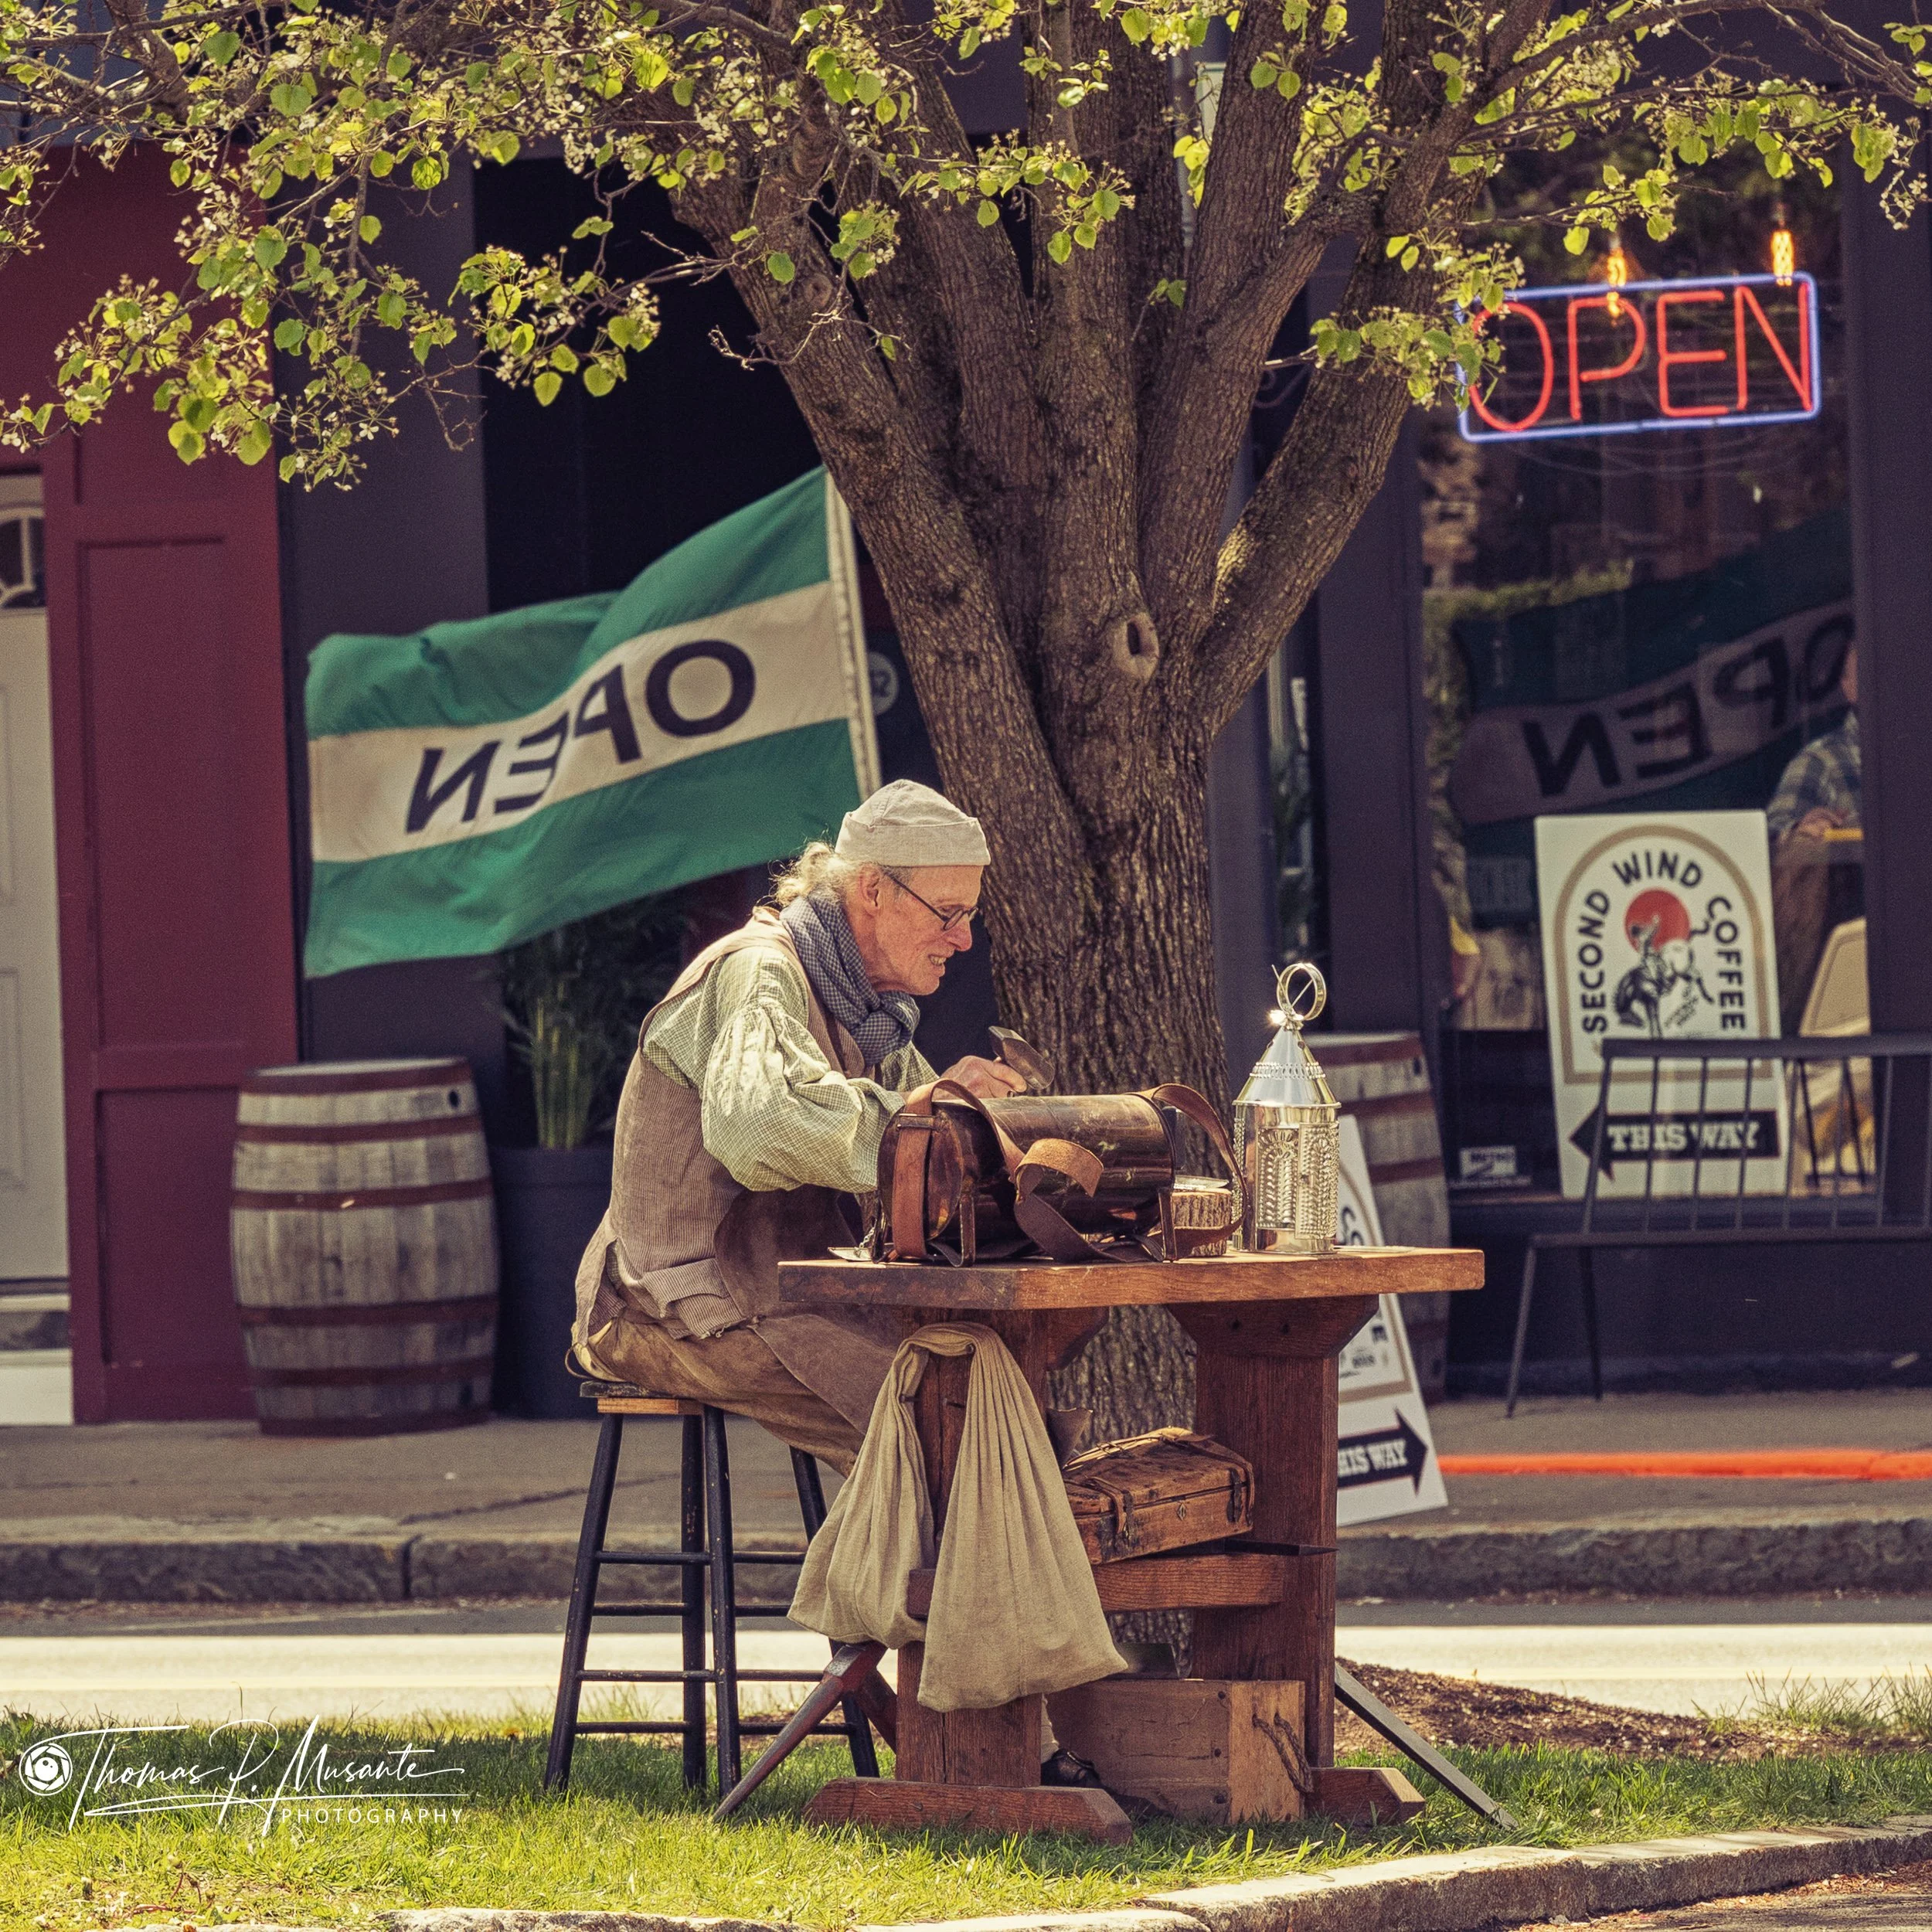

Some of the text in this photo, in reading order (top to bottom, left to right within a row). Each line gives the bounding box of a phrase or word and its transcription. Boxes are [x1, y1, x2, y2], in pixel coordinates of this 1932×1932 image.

[1468, 282, 1813, 433] OPEN
[1578, 850, 1746, 1034] SECOND WIND COFFEE
[1607, 1121, 1760, 1151] THIS WAY
[1366, 1438, 1409, 1471] WAY
